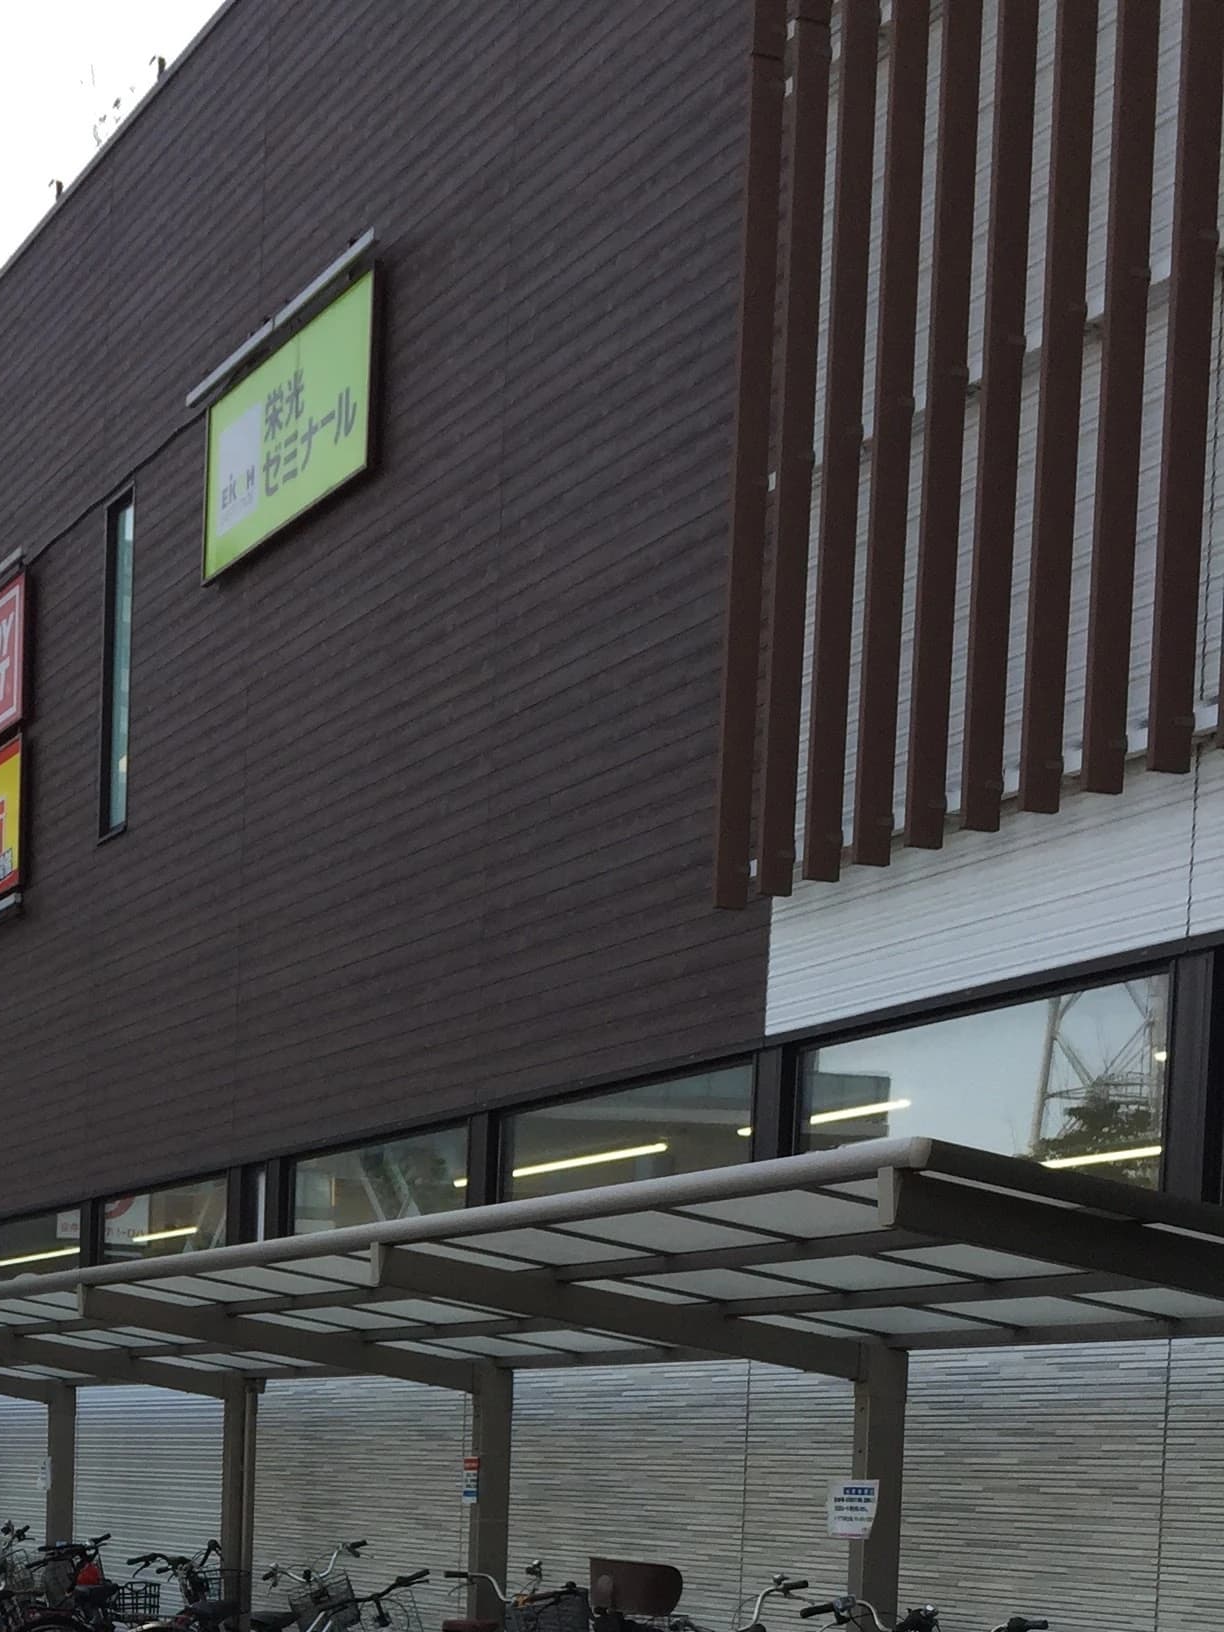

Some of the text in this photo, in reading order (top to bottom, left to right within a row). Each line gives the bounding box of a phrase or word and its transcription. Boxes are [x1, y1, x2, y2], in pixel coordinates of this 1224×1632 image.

[263, 386, 357, 496] ゼミナール
[264, 368, 304, 443] 栄光
